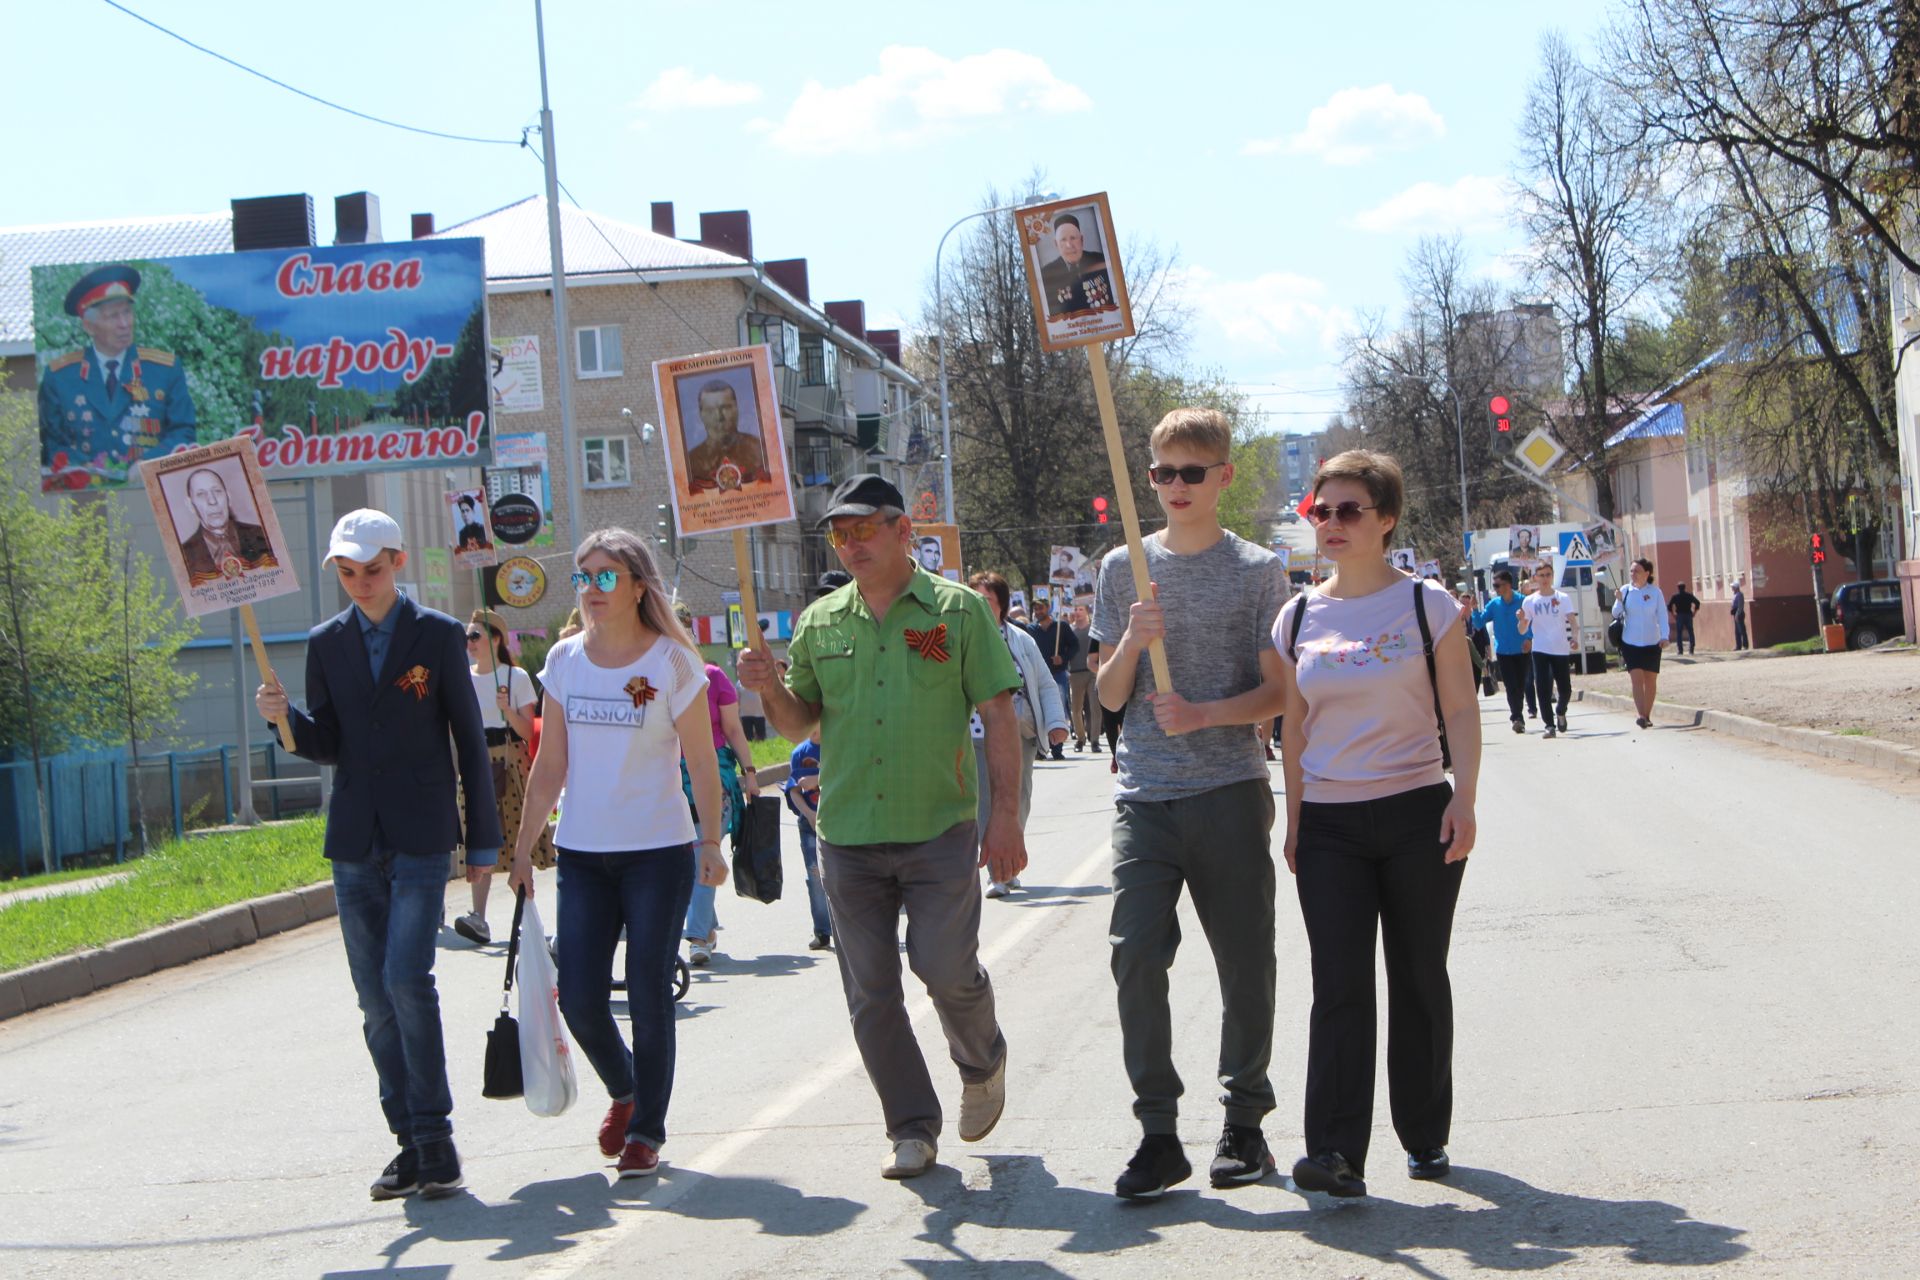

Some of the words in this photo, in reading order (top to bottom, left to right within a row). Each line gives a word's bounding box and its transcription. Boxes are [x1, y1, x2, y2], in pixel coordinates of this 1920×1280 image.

[277, 254, 423, 298] Слава
[262, 328, 453, 388] народу-
[669, 355, 729, 373] БЕССМЕРТНЫЙ
[730, 352, 753, 363] ПОЛК
[1497, 418, 1510, 432] 30
[172, 413, 483, 468] едителю!
[190, 585, 214, 598] Сафин
[568, 700, 641, 723] PASSION
